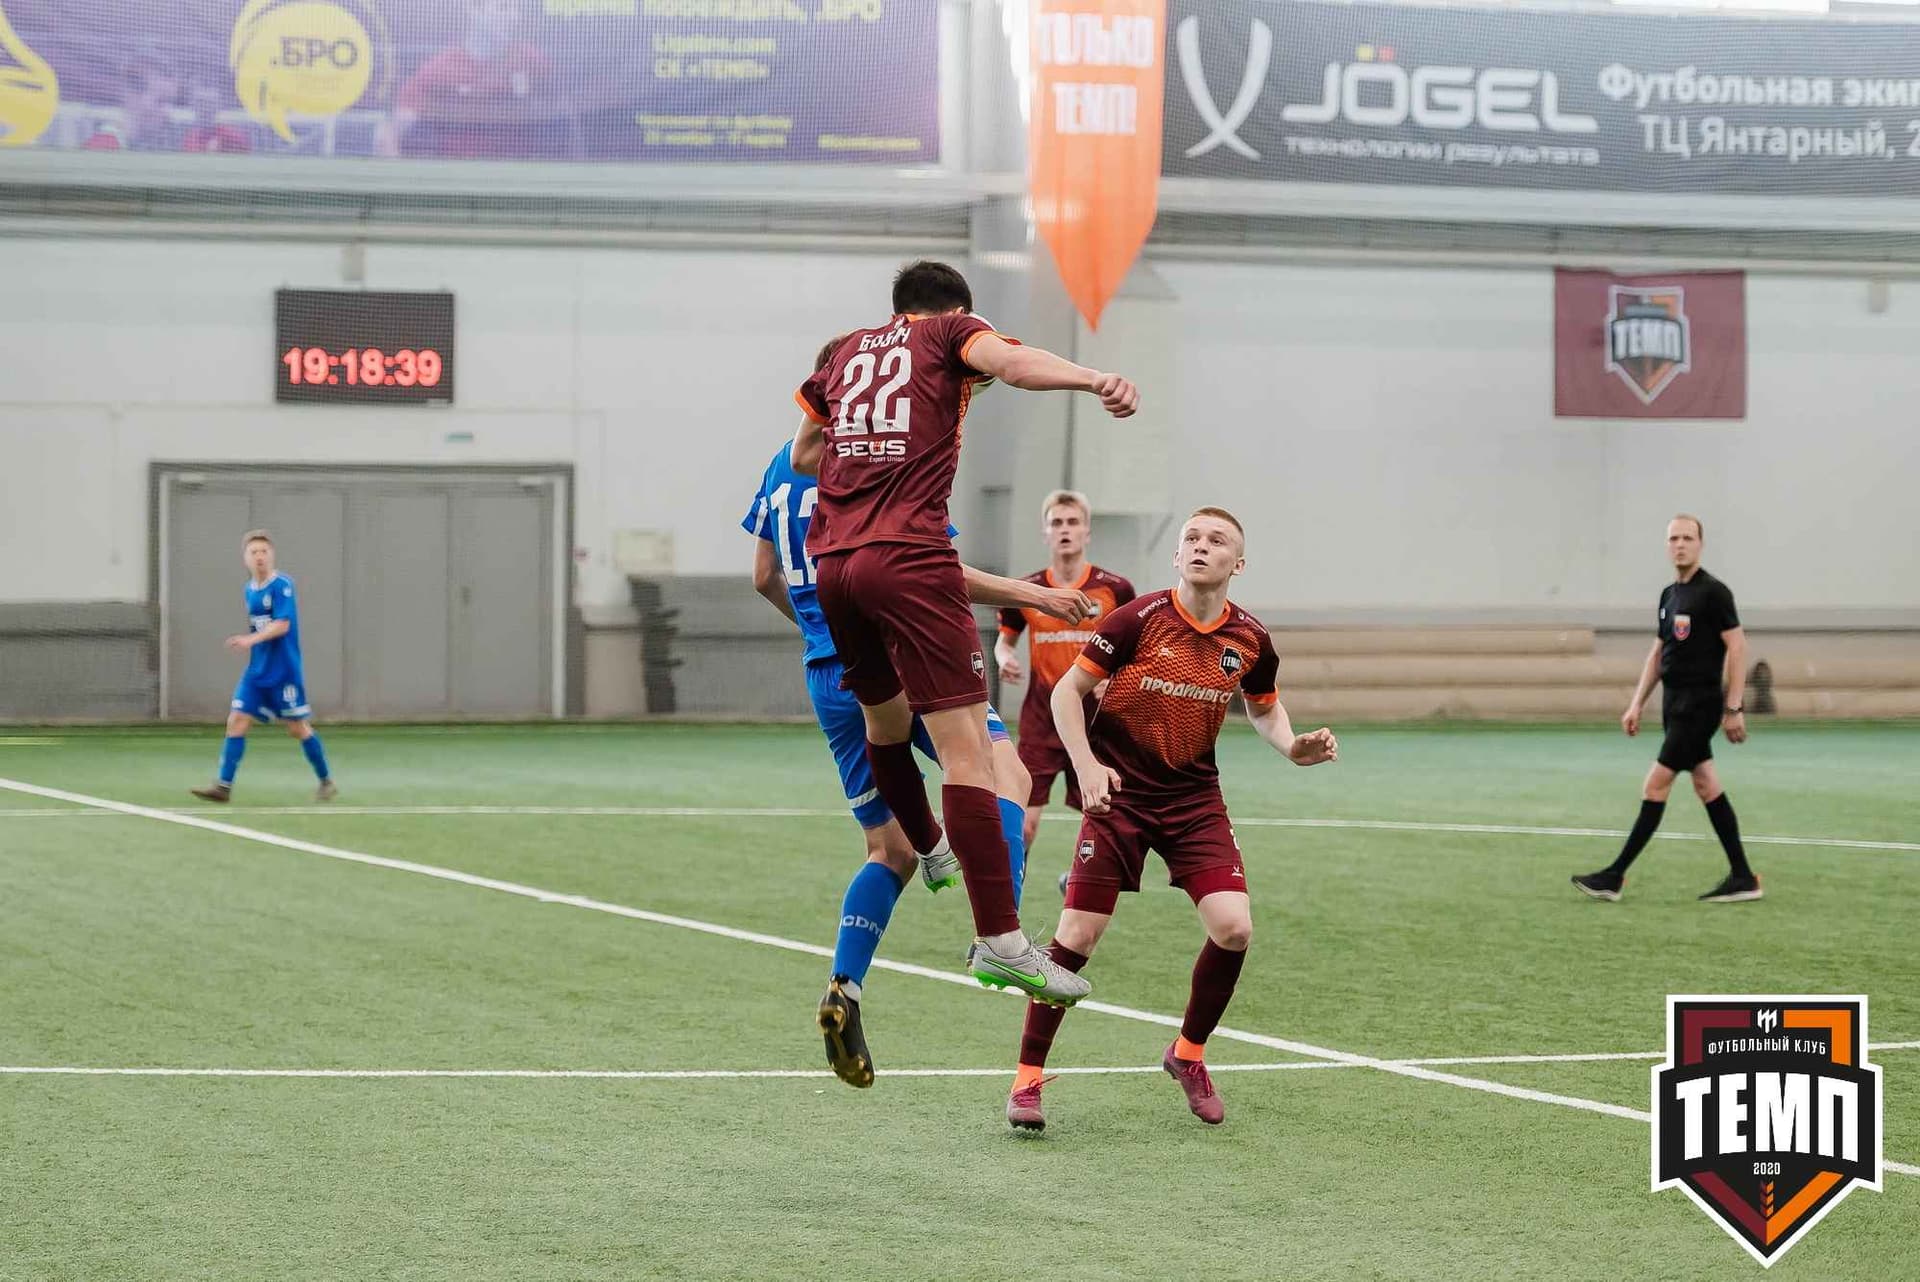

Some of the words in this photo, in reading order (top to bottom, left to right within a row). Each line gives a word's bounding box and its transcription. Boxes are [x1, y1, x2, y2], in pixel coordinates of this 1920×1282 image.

[269, 36, 358, 69] .БРО
[1037, 12, 1153, 68] ТОЛЬКО
[1599, 62, 1833, 109] Футбольная
[1285, 136, 1442, 161] технологии
[1444, 141, 1600, 167] результата
[1637, 114, 1691, 160] ТЦ
[1700, 116, 1896, 163] Янтарный,
[1614, 318, 1682, 360] ТЕМП
[283, 347, 442, 387] 19:18:39
[834, 346, 912, 437] 22
[836, 440, 906, 457] SEUS
